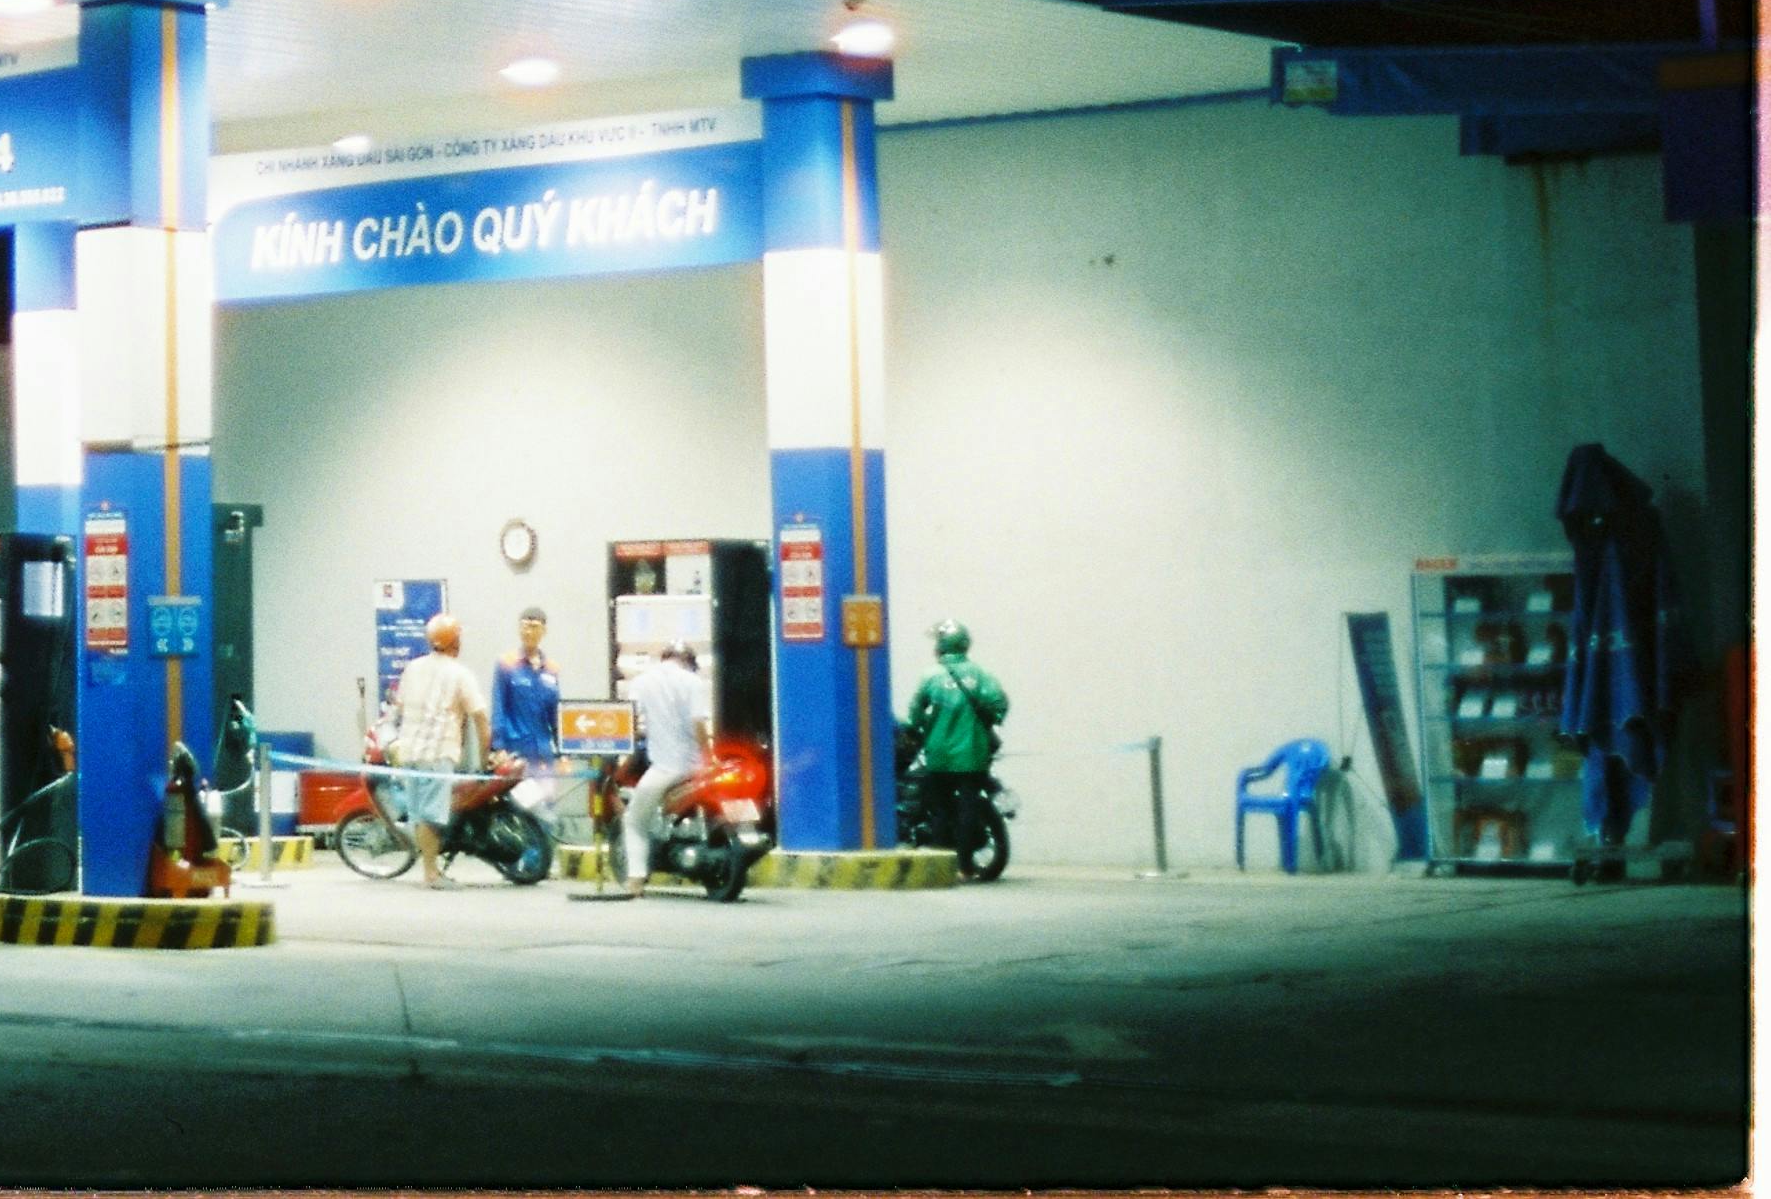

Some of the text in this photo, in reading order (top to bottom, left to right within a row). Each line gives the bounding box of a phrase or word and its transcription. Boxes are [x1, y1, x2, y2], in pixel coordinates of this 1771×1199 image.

[482, 138, 499, 155] TY
[689, 116, 718, 134] MTV
[250, 179, 720, 269] KÍNH CHÀO QUÝ KHÁCH
